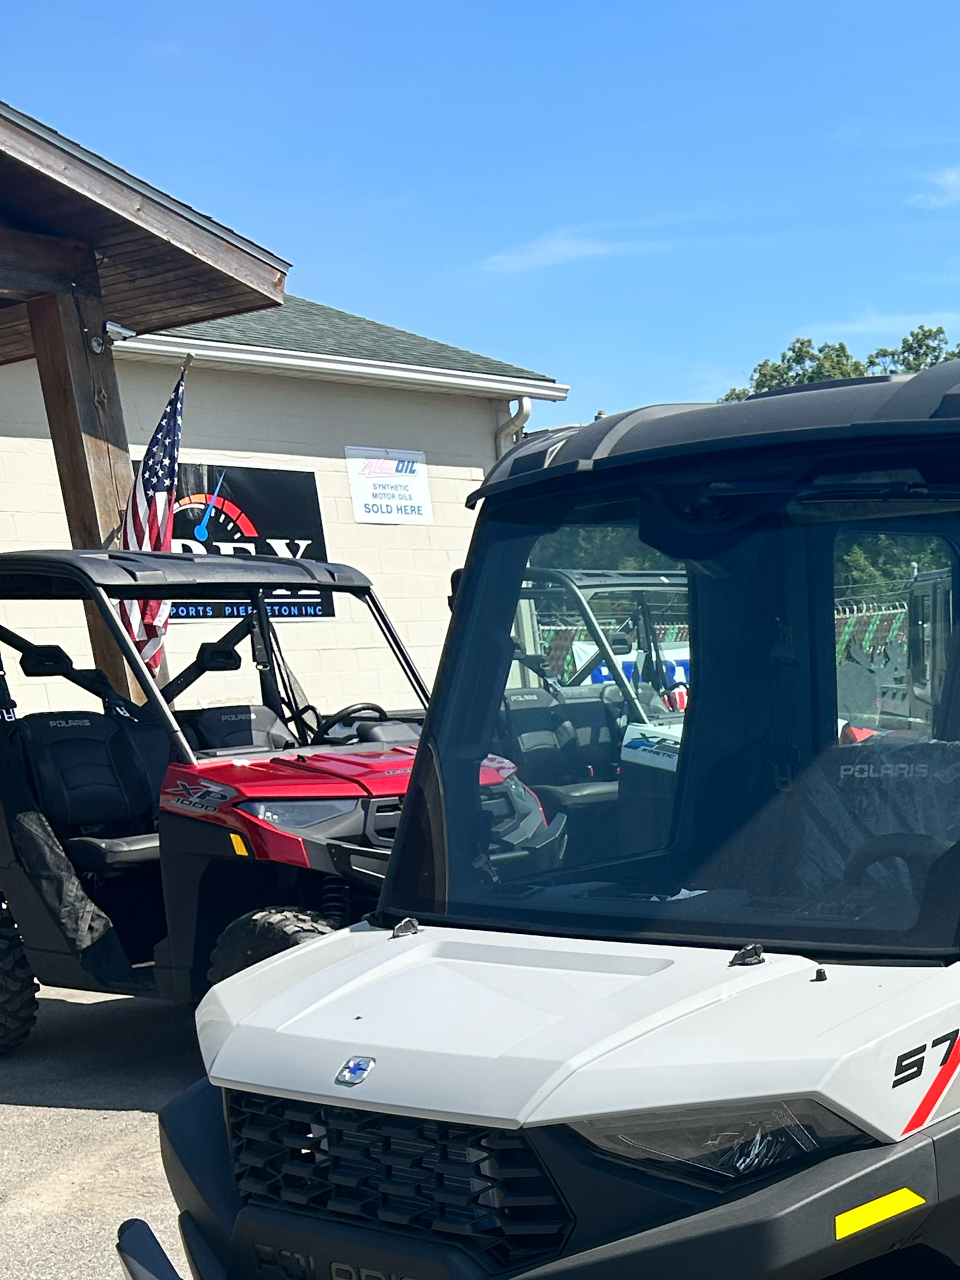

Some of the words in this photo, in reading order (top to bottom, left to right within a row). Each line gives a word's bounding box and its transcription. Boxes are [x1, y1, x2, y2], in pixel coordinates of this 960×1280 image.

[373, 483, 410, 492] SYNTHETIC
[372, 492, 396, 500] MOTOR
[398, 493, 413, 501] OILS
[364, 503, 393, 514] SOLD
[396, 505, 423, 515] HERE
[302, 605, 323, 615] INC
[49, 719, 91, 728] POLARIS
[642, 748, 675, 760] KINETIC
[840, 764, 928, 779] POLARIS
[176, 797, 219, 813] 1000
